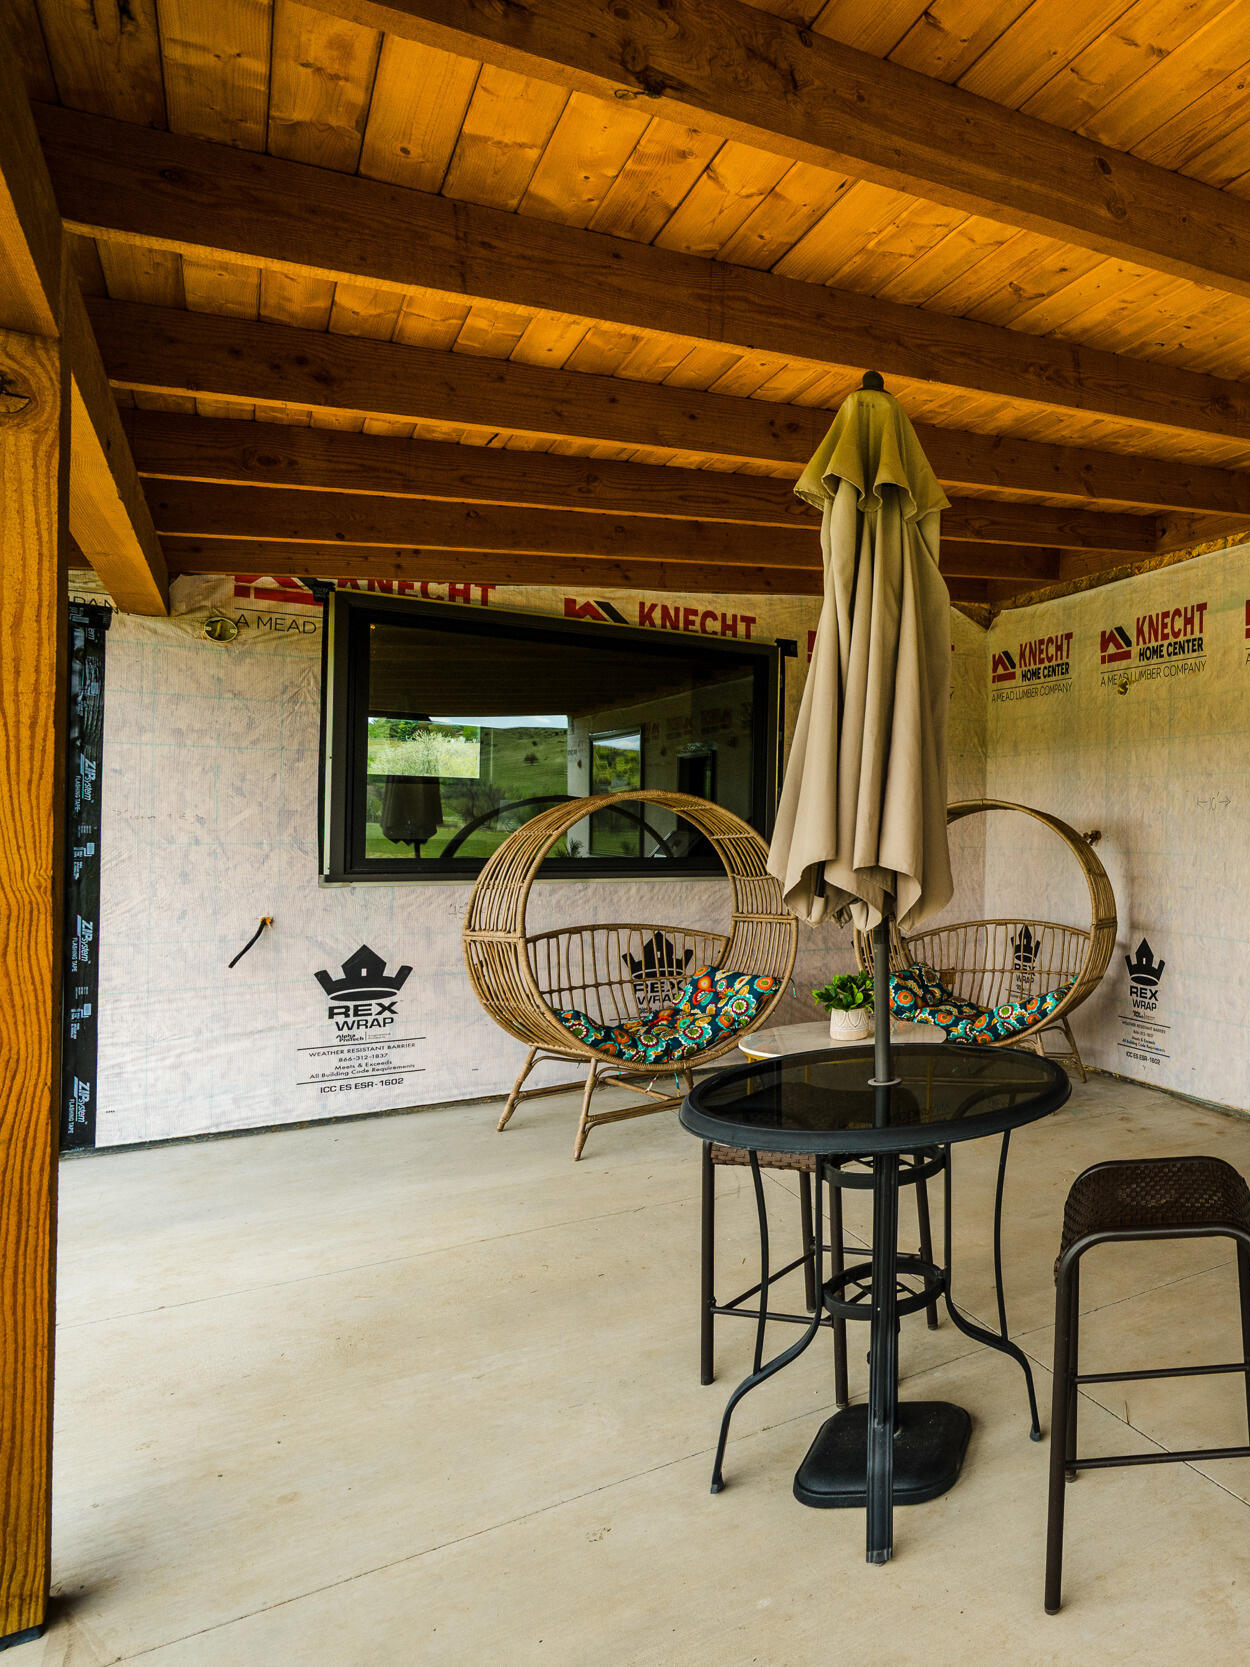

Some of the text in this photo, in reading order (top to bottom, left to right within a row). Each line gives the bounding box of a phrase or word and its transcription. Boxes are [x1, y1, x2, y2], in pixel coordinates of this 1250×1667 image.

[236, 614, 317, 634] A MEAD
[639, 601, 756, 639] KNECHT
[1136, 602, 1208, 646] KNECHT
[1019, 632, 1073, 668] KNECHT
[1139, 636, 1204, 662] HOME CENTER
[1021, 661, 1070, 683] HOME CENTER
[1100, 676, 1106, 688] A
[1130, 667, 1161, 682] LUMBER
[1163, 660, 1207, 678] COMPANY
[1039, 681, 1073, 697] COMPANY
[638, 994, 677, 1005] WRA
[1130, 986, 1159, 1001] REX
[328, 1001, 399, 1019] REX
[1132, 999, 1157, 1012] WRAP
[335, 1017, 394, 1031] WRAP
[308, 1049, 344, 1057] WEATHER
[347, 1046, 384, 1054] RESISTANT
[321, 1070, 349, 1078] Building
[371, 1064, 415, 1073] Requirements
[335, 1063, 356, 1071] Meets
[365, 1060, 392, 1068] Exceeds
[321, 1085, 337, 1094] ICC
[340, 1083, 352, 1092] ES
